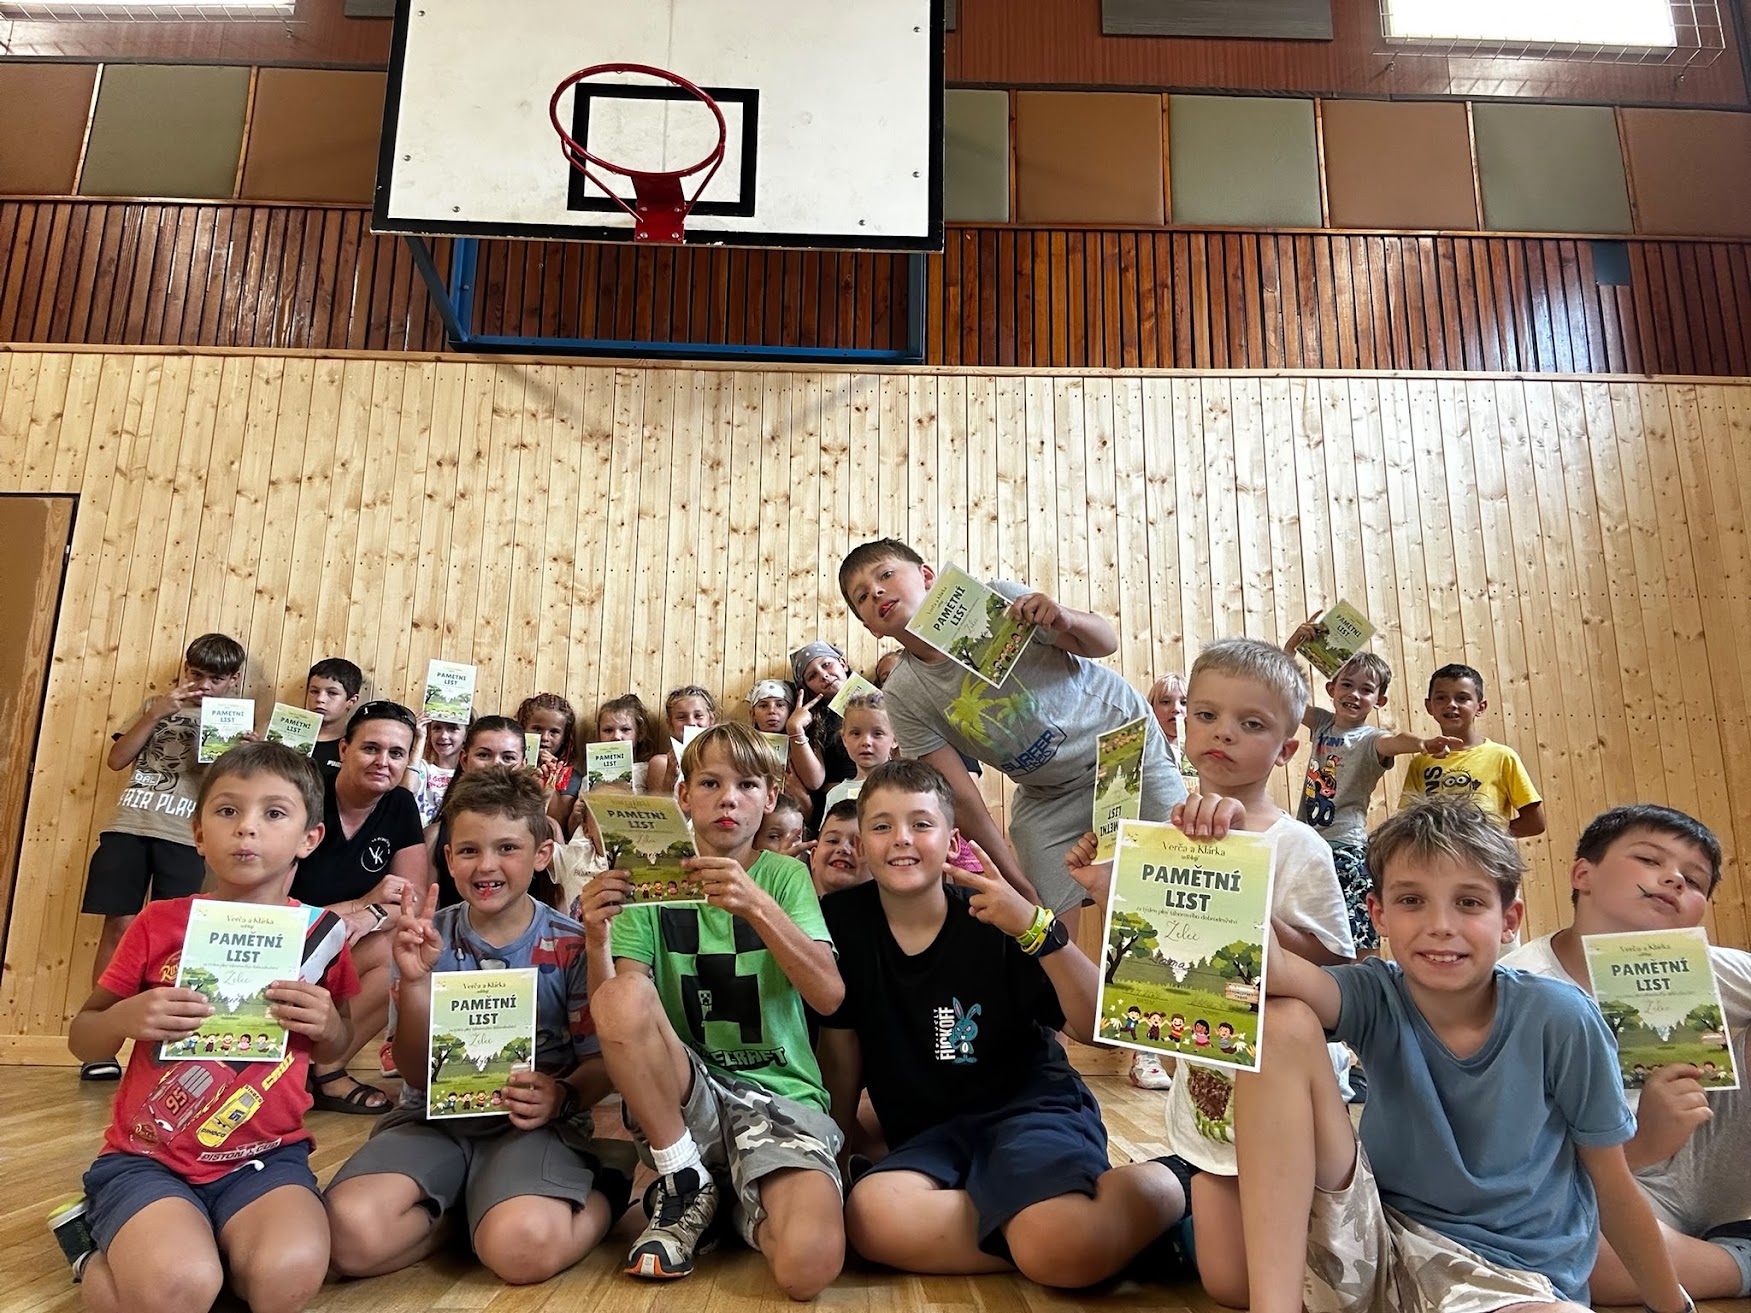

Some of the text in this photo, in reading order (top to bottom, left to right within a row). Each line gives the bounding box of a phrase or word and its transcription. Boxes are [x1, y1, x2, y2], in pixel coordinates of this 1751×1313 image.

[950, 604, 968, 626] LIST
[1337, 625, 1350, 636] LIST
[155, 794, 196, 818] PLAY
[1108, 806, 1122, 819] LIST
[628, 821, 655, 829] LIST
[1162, 841, 1187, 850] Verča
[1198, 845, 1226, 856] Klárka
[1142, 864, 1241, 892] PAMĚTNÍ
[1166, 890, 1211, 911] LIST
[209, 931, 283, 948] PAMĚTNÍ
[226, 950, 261, 963] LIST
[1611, 957, 1690, 976] PAMĚTNÍ
[1637, 978, 1670, 991] LIST
[451, 994, 517, 1011] PAMĚTNÍ
[469, 1013, 498, 1026] LIST
[706, 1046, 788, 1068] ECRAFT
[165, 1086, 188, 1116] 95
[244, 1085, 262, 1102] DINOCO
[200, 1128, 226, 1138] DINOCO
[202, 1141, 280, 1160] PISTON CUP
